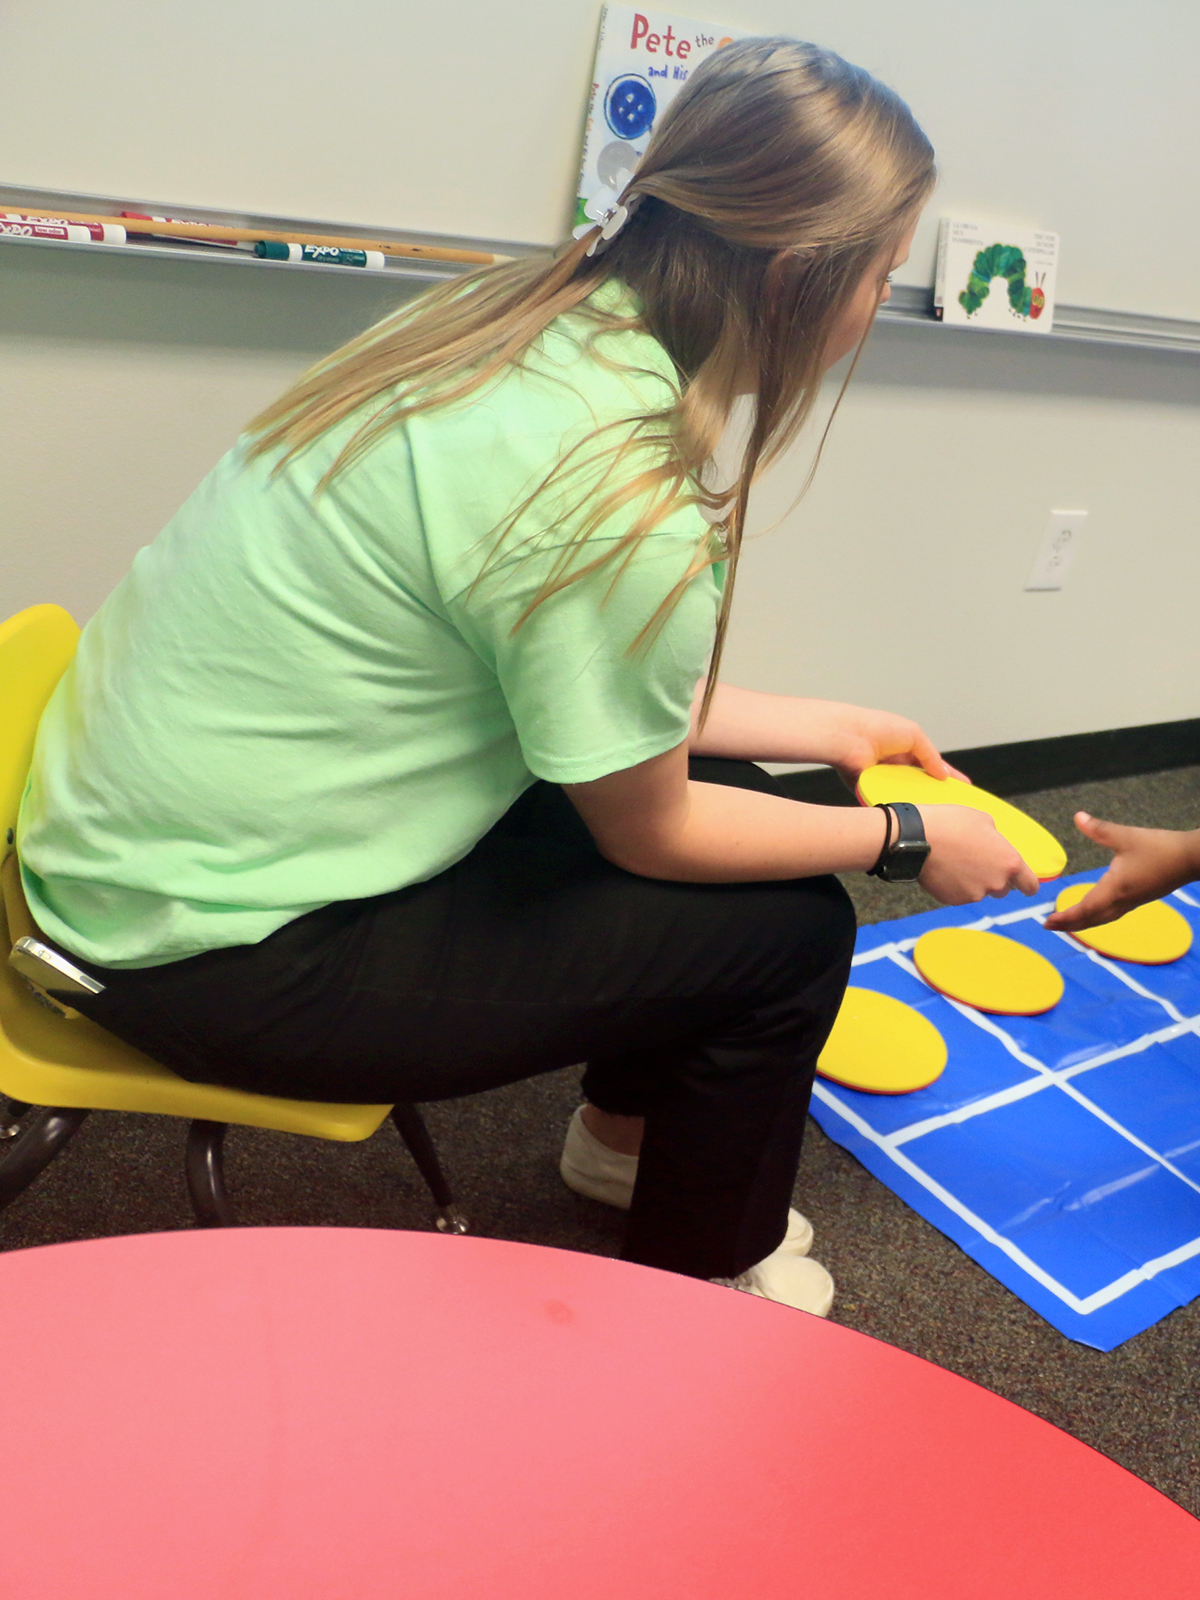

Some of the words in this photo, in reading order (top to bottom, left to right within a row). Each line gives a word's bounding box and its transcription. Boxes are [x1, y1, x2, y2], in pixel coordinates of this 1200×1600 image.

[630, 13, 691, 59] Pete
[695, 34, 715, 48] the
[648, 64, 668, 79] and
[673, 65, 688, 81] His
[0, 222, 33, 237] XPO
[305, 244, 340, 259] EXPO
